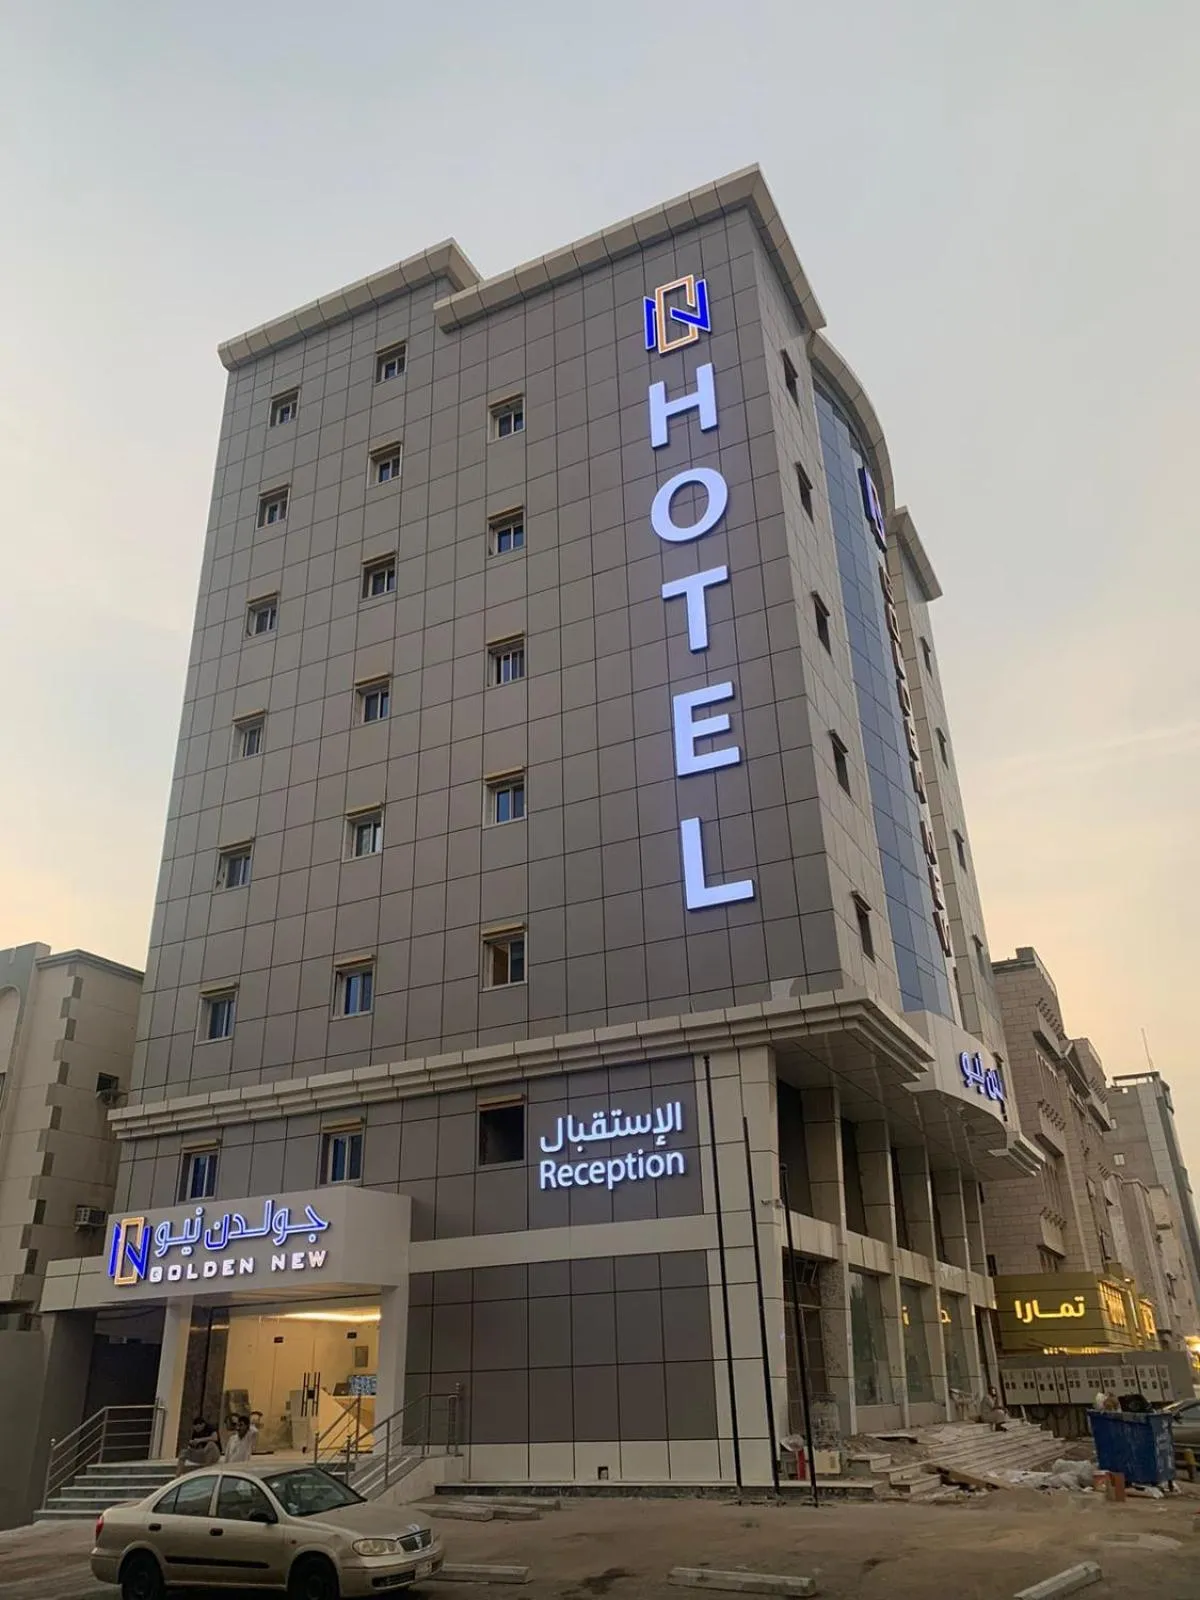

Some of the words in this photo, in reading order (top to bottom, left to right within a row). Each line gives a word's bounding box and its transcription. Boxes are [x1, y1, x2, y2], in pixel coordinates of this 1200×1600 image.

[648, 362, 755, 911] HOTEL
[540, 1101, 682, 1152] الإستقبال
[540, 1149, 684, 1189] Reception
[154, 1206, 204, 1257] نيو
[203, 1200, 329, 1250] جولدن
[149, 1257, 254, 1283] GOLDEN
[271, 1250, 327, 1272] NEW
[1014, 1296, 1086, 1324] تمارا
